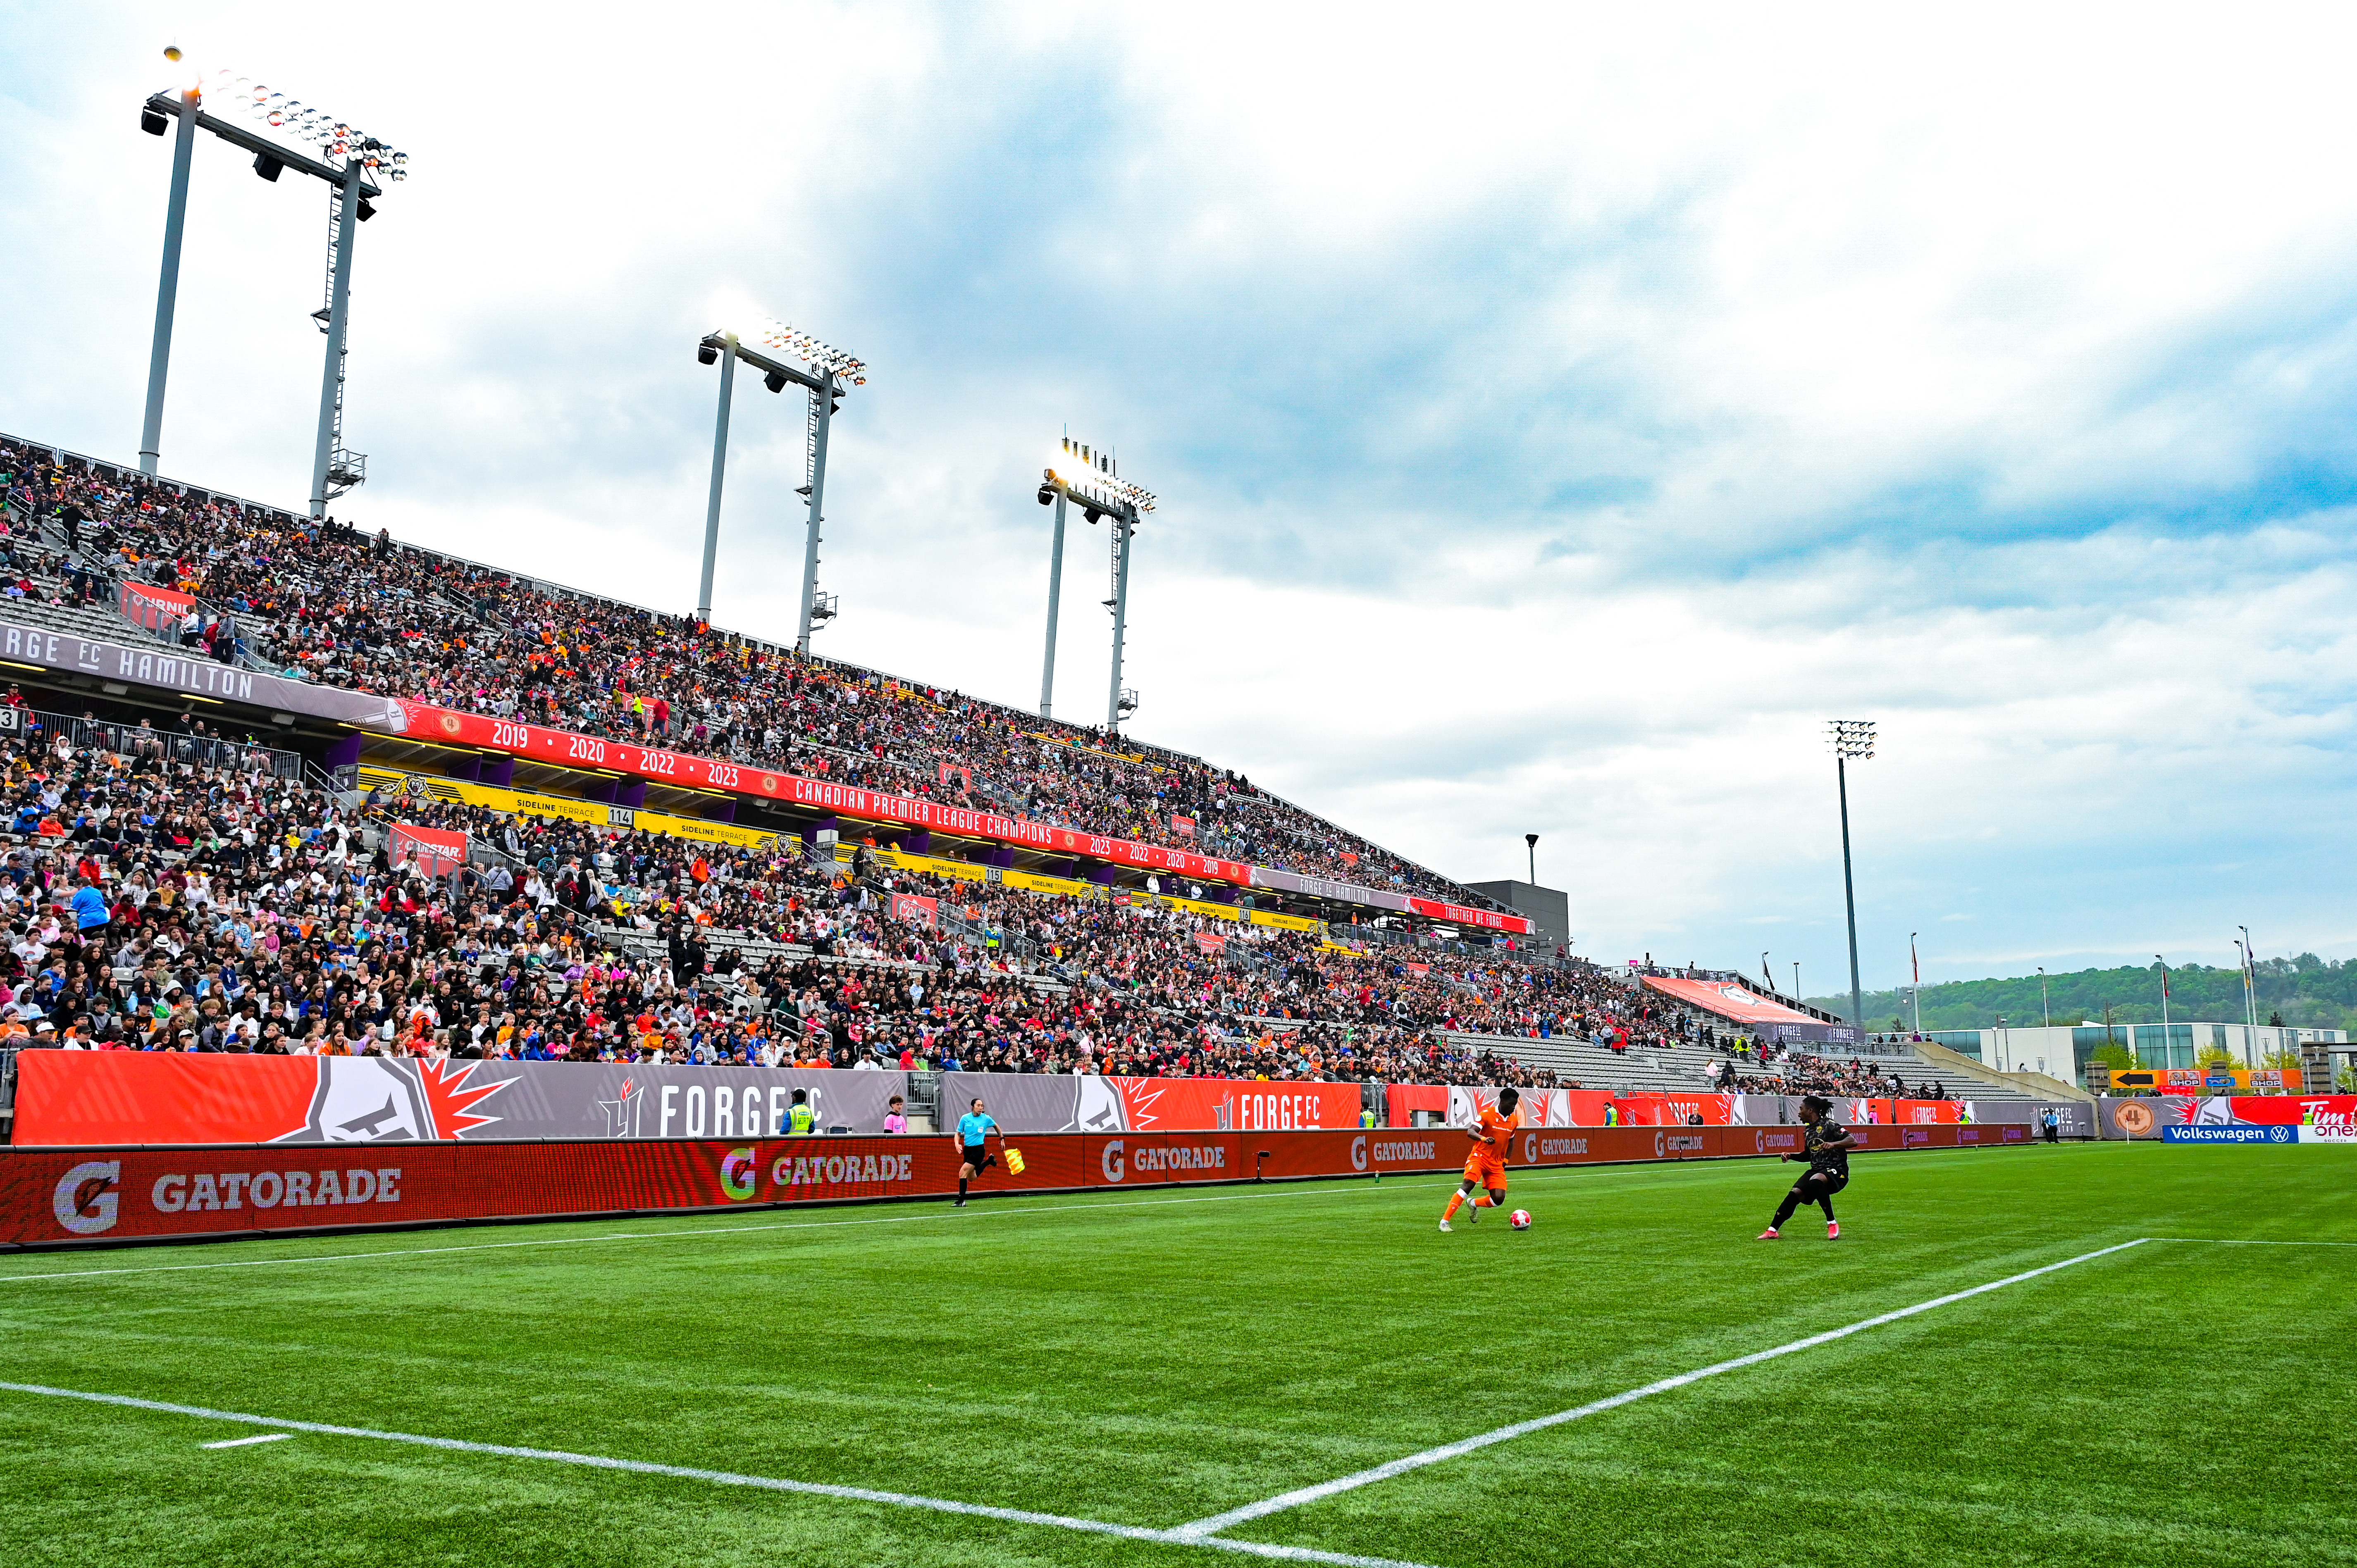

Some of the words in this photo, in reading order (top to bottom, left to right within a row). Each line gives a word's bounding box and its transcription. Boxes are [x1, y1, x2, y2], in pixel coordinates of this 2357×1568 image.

[79, 643, 101, 663] FC
[120, 651, 252, 699] HAMILTON
[492, 722, 528, 748] 2019
[569, 736, 604, 763] 2020
[639, 750, 674, 776] 2022
[708, 763, 738, 787] 2023
[517, 799, 556, 811] SIDELINE
[558, 805, 595, 817] TERRACE
[610, 809, 630, 823] 114
[796, 780, 865, 810] CANADIAN
[873, 794, 929, 822] PREMIER
[936, 807, 980, 832] LEAGUE
[987, 816, 1051, 845] CHAMPIONS
[681, 825, 715, 836] SIDELINE
[717, 830, 747, 841] TERRACE
[1090, 837, 1111, 855] 2023
[1130, 844, 1148, 862] 2022
[1166, 852, 1185, 869] 2020
[1203, 859, 1218, 875] 2019
[932, 864, 957, 873] SIDELINE
[958, 868, 982, 877] TERRACE
[986, 868, 1000, 880] 115
[1031, 880, 1054, 888] SIDELINE
[1054, 884, 1075, 892] TERRACE
[1300, 878, 1322, 895] FORGE
[1326, 884, 1332, 893] FC
[1336, 885, 1370, 903] HAMILTON
[1240, 909, 1249, 919] 116
[1445, 906, 1473, 923] TOGETHER
[1476, 913, 1484, 924] WE
[1486, 914, 1503, 928] FORGE
[1419, 937, 1429, 946] 117
[1779, 1025, 1796, 1036] FORGE
[1833, 1028, 1849, 1039] FORGE
[661, 1085, 786, 1136] FORGE
[1241, 1094, 1302, 1129] FORGE
[1306, 1096, 1320, 1120] FC
[1917, 1106, 1932, 1124] FORGE
[2065, 1108, 2072, 1119] FC
[2299, 1101, 2345, 1125] Tim
[1962, 1130, 1979, 1140] GATORADE
[2007, 1130, 2022, 1139] GATORADE
[2170, 1126, 2264, 1142] Volkswagen
[2314, 1125, 2354, 1137] one
[1524, 1133, 1537, 1163] G
[1541, 1138, 1587, 1155] GATORADE
[1667, 1136, 1703, 1151] GATORADE
[1765, 1134, 1795, 1147] GATORADE
[1102, 1140, 1124, 1182] G
[1134, 1146, 1225, 1171] GATORADE
[1351, 1136, 1367, 1171] G
[1373, 1141, 1435, 1161] GATORADE
[720, 1147, 756, 1201] G
[772, 1154, 912, 1186] GATORADE
[52, 1160, 120, 1234] G
[152, 1168, 401, 1213] GATORADE
